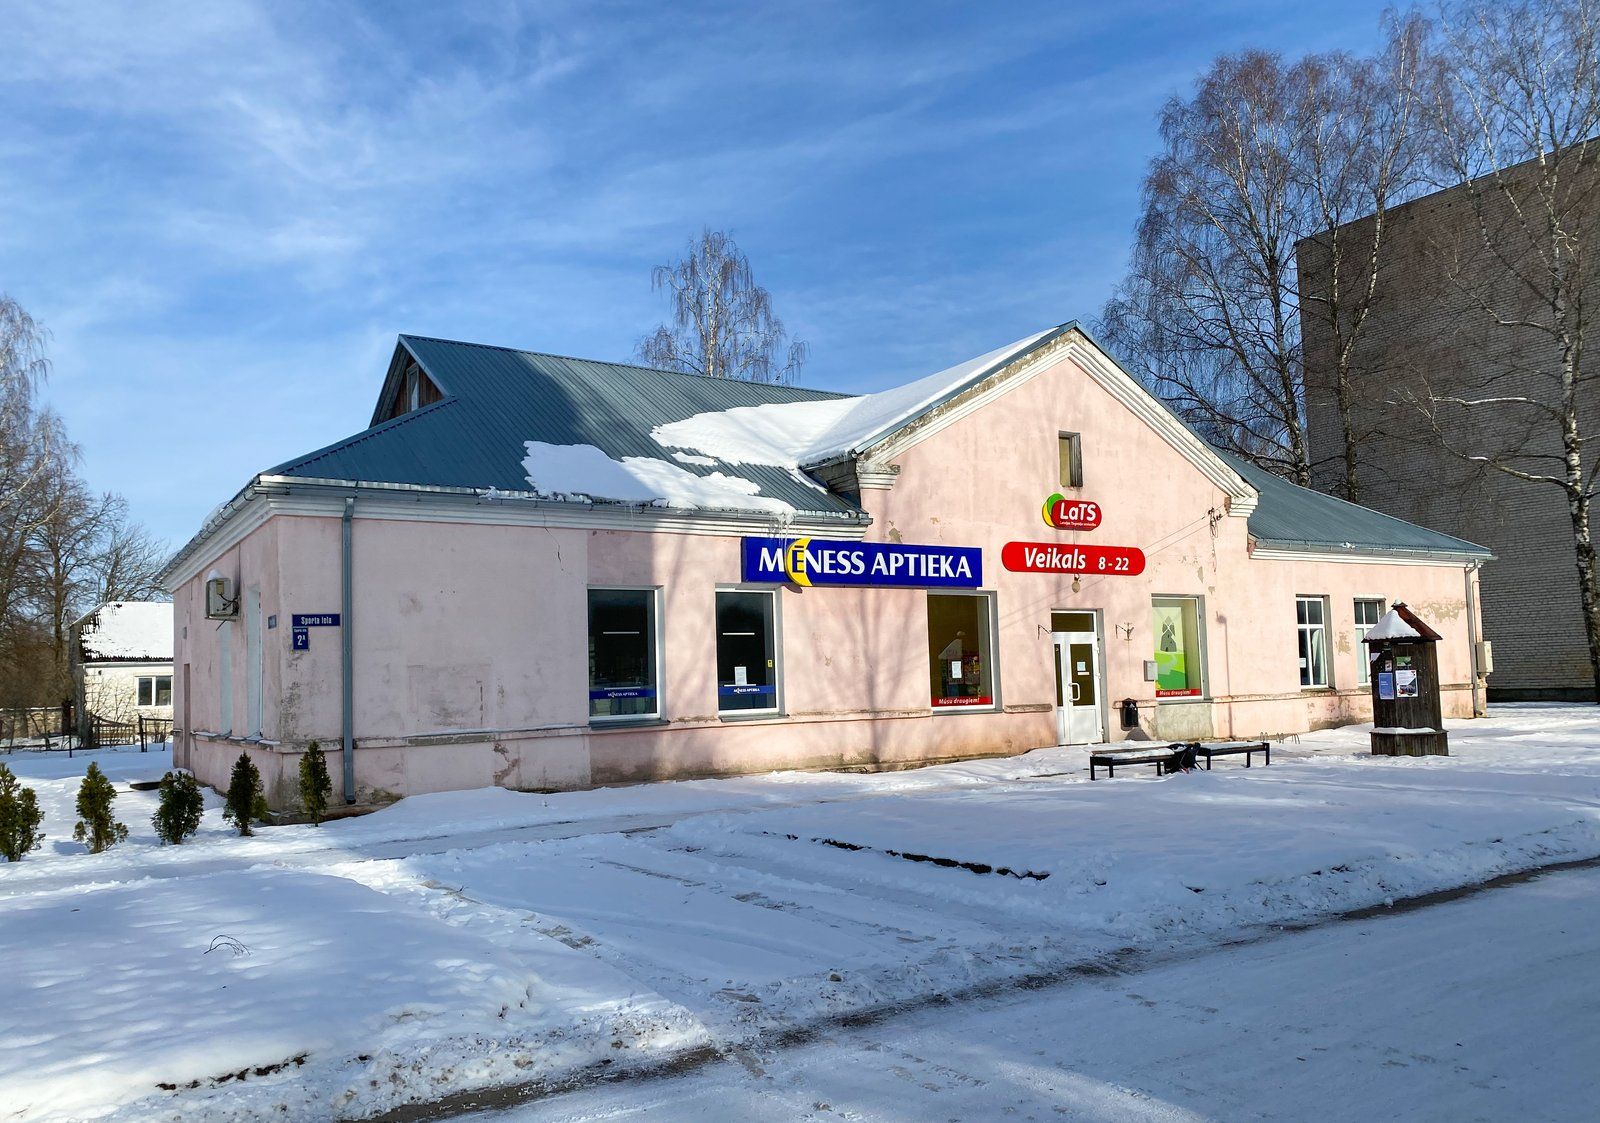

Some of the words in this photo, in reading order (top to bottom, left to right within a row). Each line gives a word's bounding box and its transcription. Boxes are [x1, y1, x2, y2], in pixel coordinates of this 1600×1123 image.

[1060, 502, 1096, 521] LaTS
[758, 545, 865, 575] MĒNESS
[871, 552, 972, 578] APTIEKA
[1024, 547, 1086, 569] Veikals
[301, 616, 320, 625] Sporta
